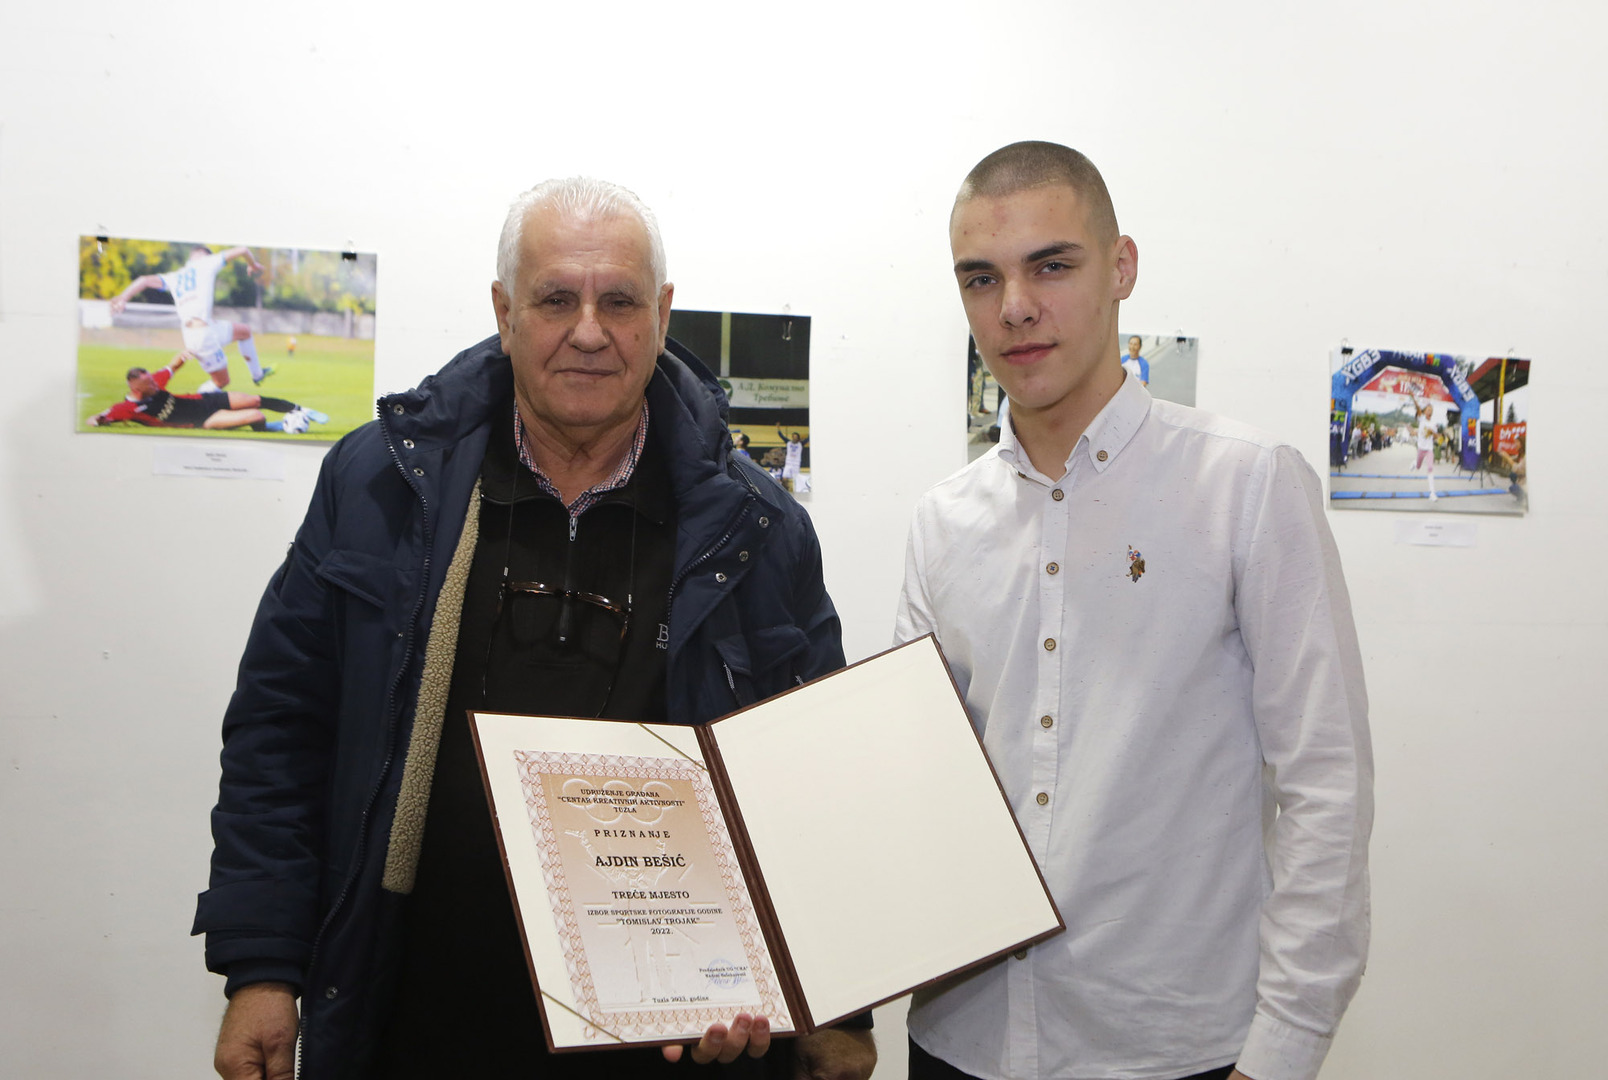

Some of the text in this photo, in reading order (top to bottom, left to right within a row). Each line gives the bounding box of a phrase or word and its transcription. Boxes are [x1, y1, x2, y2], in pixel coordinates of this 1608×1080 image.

[595, 853, 686, 867] AJDIN BEŠIĆ
[649, 890, 690, 900] MJESTO
[616, 917, 700, 926] "TOMISLAV TROJAK"
[650, 927, 674, 935] 2022.
